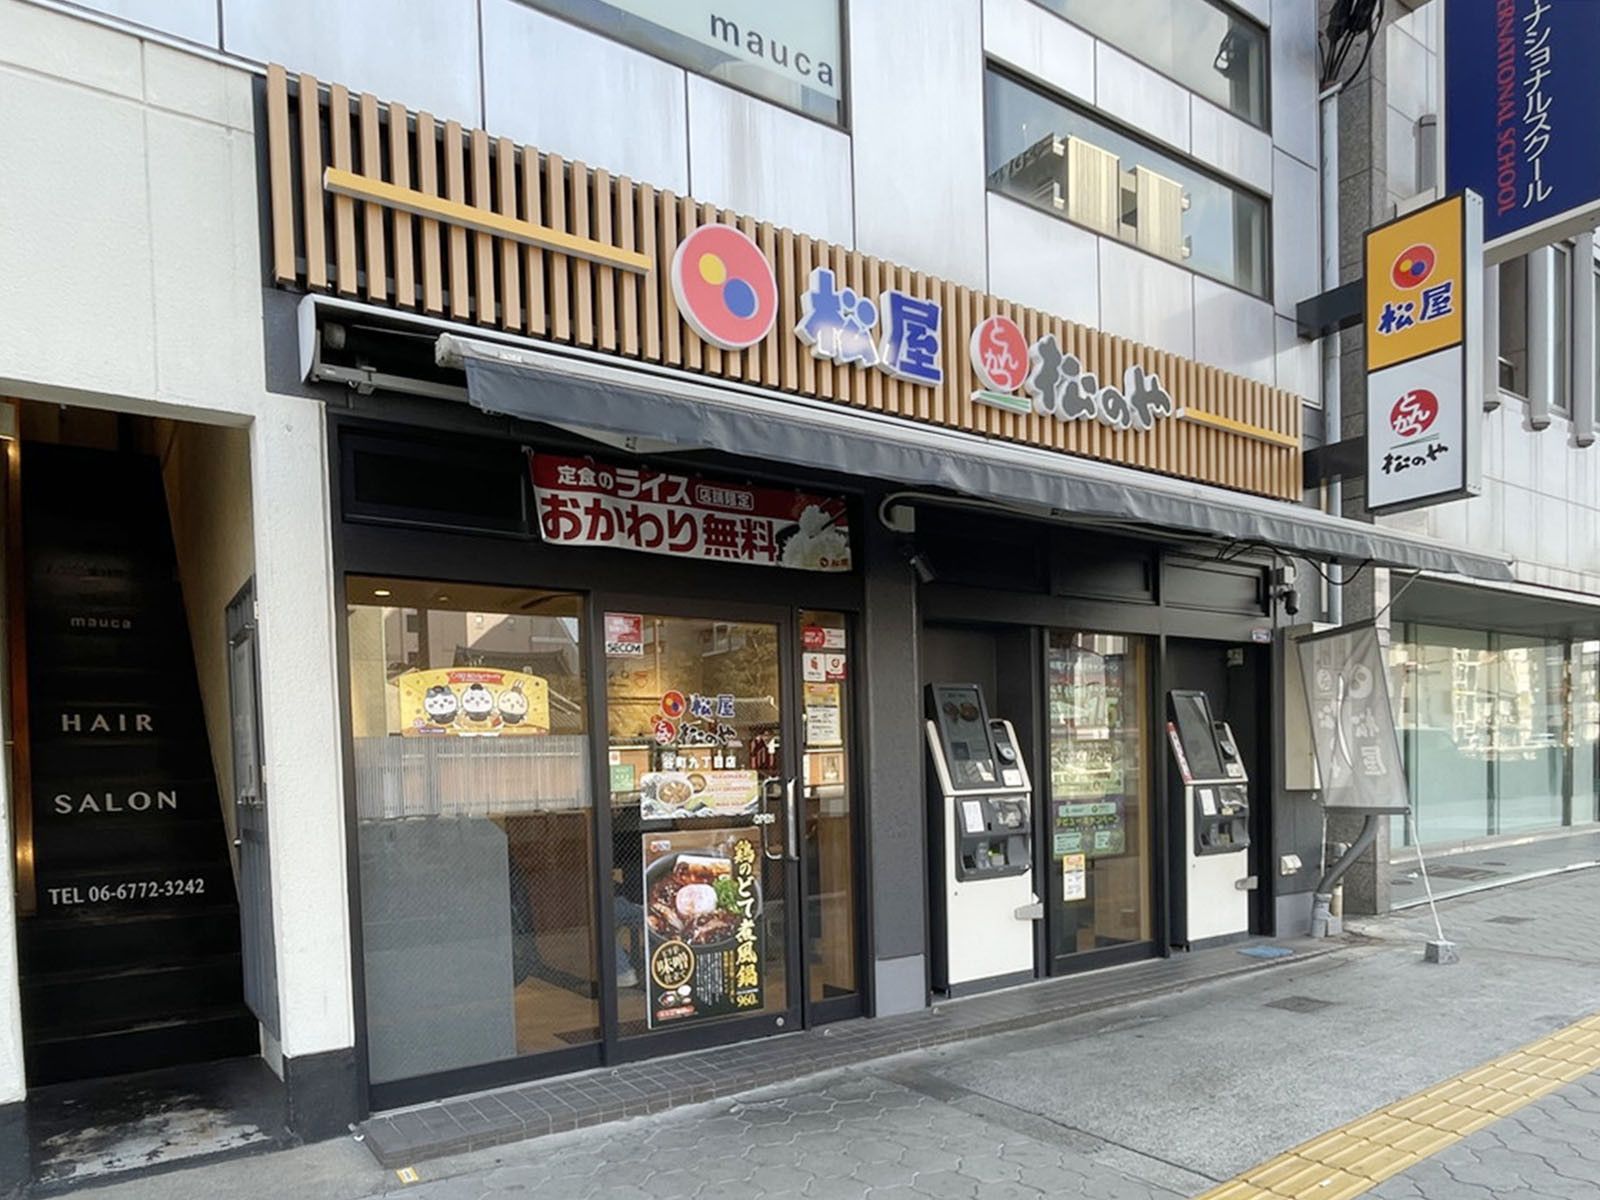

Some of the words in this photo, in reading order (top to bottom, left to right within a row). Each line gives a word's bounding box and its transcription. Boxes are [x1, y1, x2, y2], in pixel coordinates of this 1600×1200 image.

[711, 13, 833, 86] mauca
[1523, 0, 1552, 208] ナショナルスクール
[1496, 127, 1516, 216] SCHOOL
[796, 266, 943, 387] 松屋
[1377, 282, 1453, 334] 松屋
[1028, 334, 1172, 431] 松のや
[1382, 443, 1449, 474] 松のや
[557, 465, 691, 505] 定食のライス
[541, 494, 777, 562] おかわり無料
[70, 615, 131, 630] mauca
[607, 643, 641, 653] SECOM
[61, 713, 153, 732] HAIR
[690, 693, 735, 717] 松屋
[54, 790, 177, 814] SALON
[49, 888, 84, 905] TEL
[88, 878, 205, 902] 06-6772-3242
[733, 840, 759, 988] 鶏のどて煮風鍋
